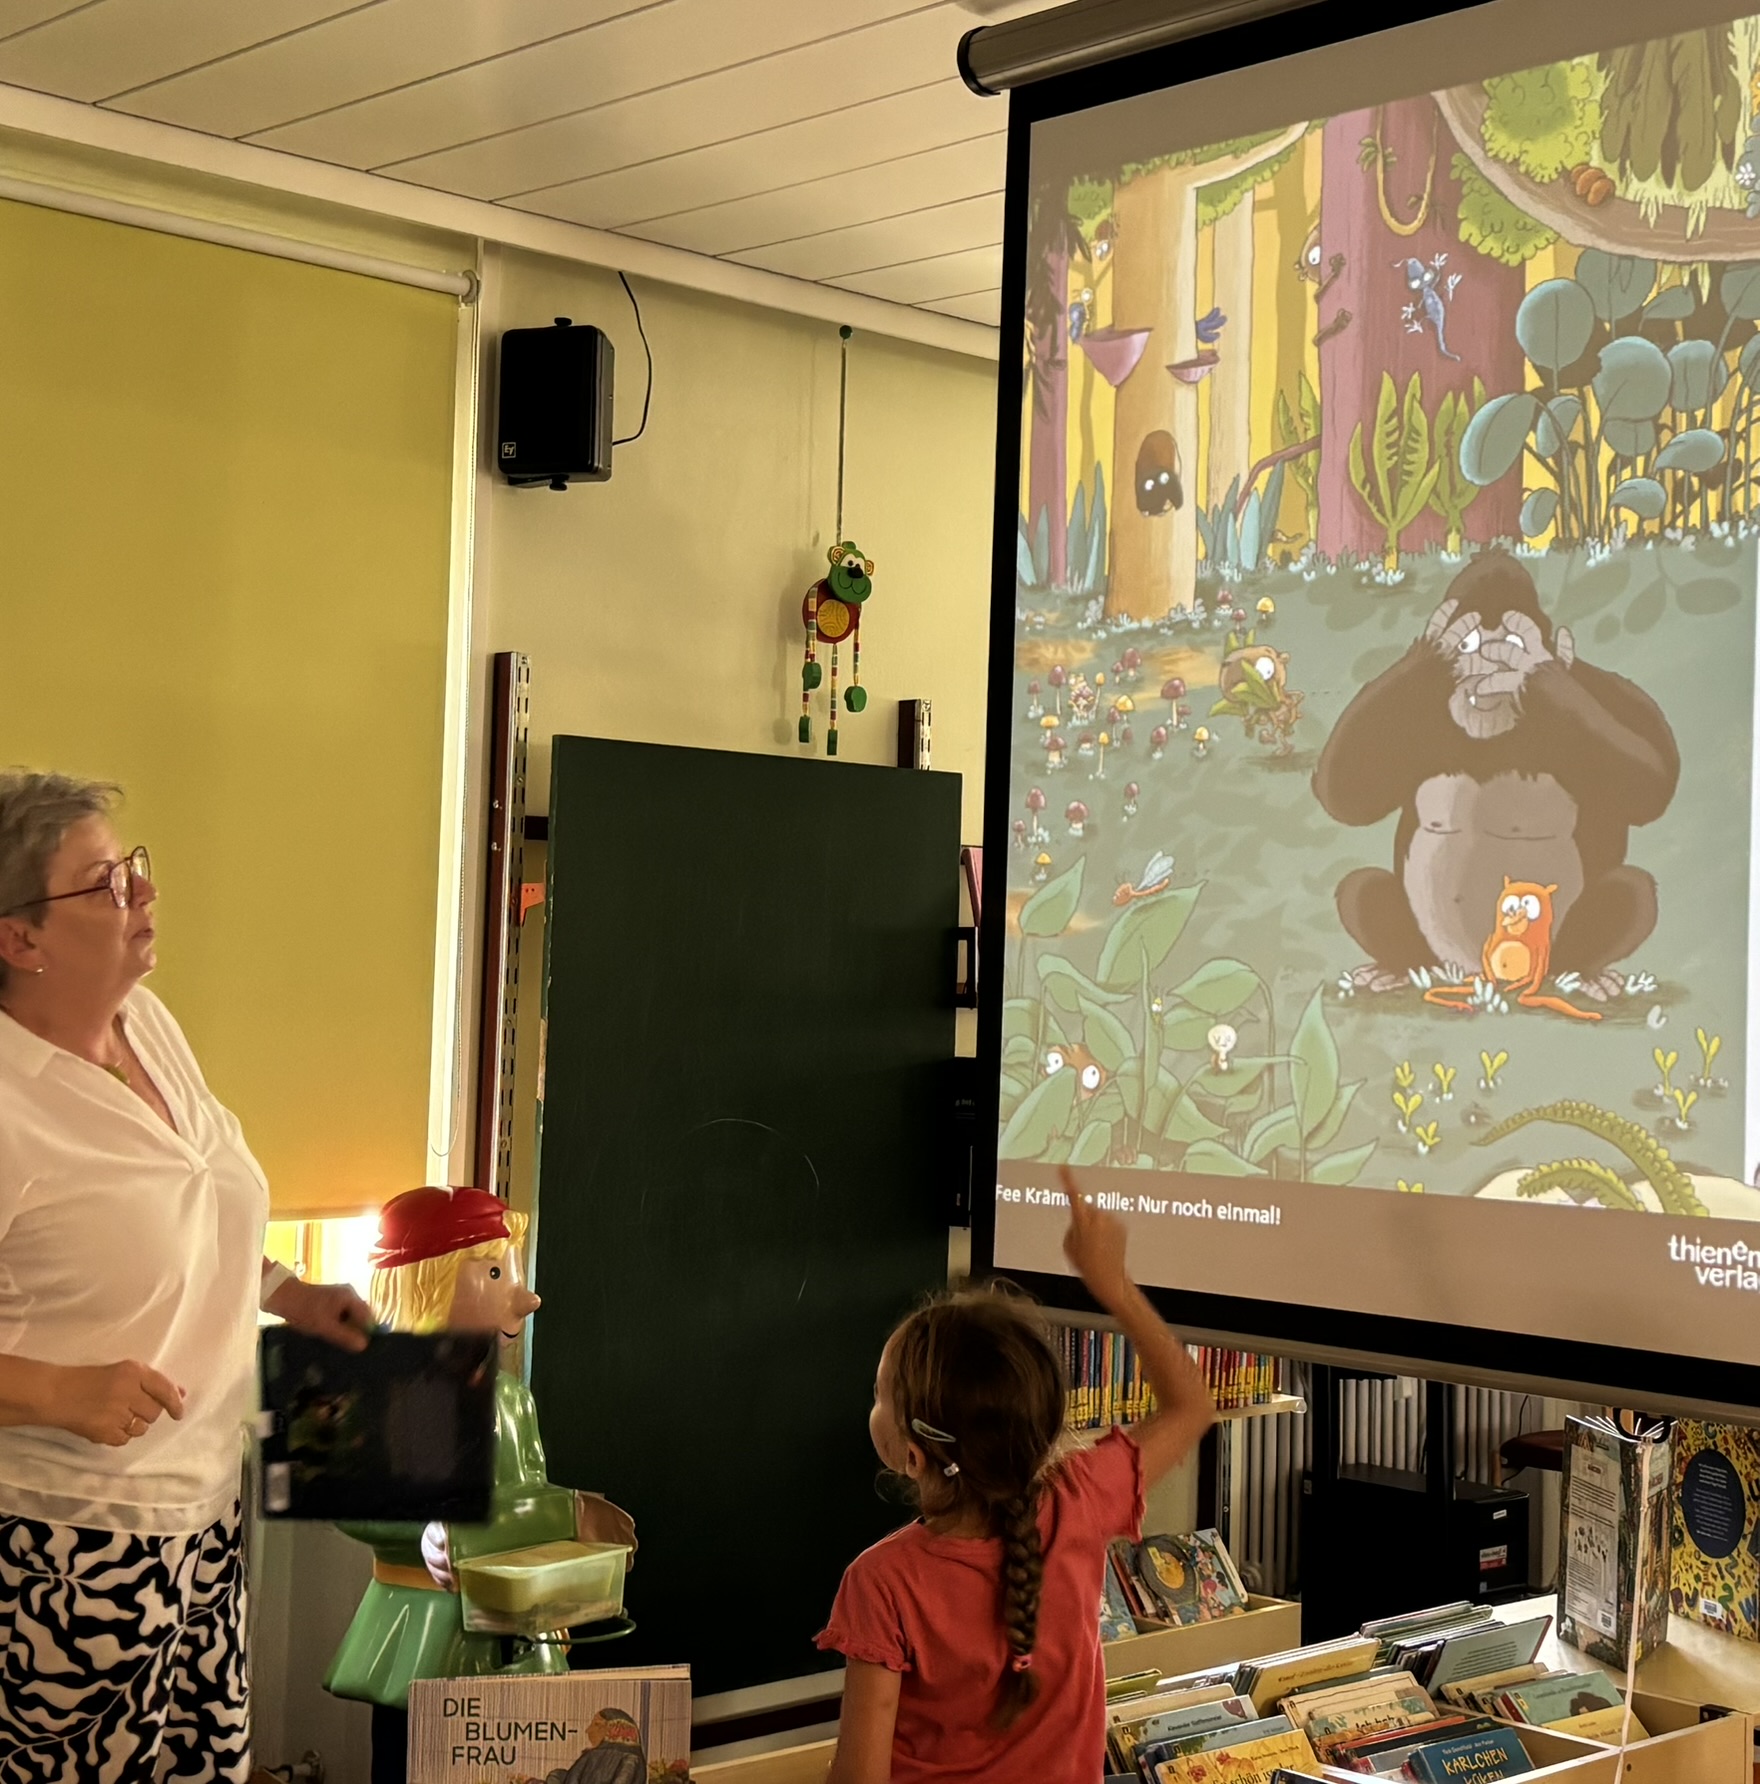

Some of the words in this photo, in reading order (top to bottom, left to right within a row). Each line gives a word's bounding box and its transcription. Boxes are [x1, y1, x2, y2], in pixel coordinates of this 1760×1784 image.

[996, 1184, 1022, 1203] Fee
[1026, 1187, 1082, 1207] Kräm
[1097, 1191, 1135, 1212] Rille:
[1138, 1195, 1167, 1215] Nur
[1172, 1199, 1212, 1219] noch
[1217, 1204, 1281, 1225] einmal!
[1694, 1264, 1760, 1292] verla
[443, 1697, 481, 1718] DIE
[465, 1721, 578, 1742] BLUMEN-
[452, 1745, 516, 1766] FRAU
[1441, 1746, 1509, 1776] KARLCHEN
